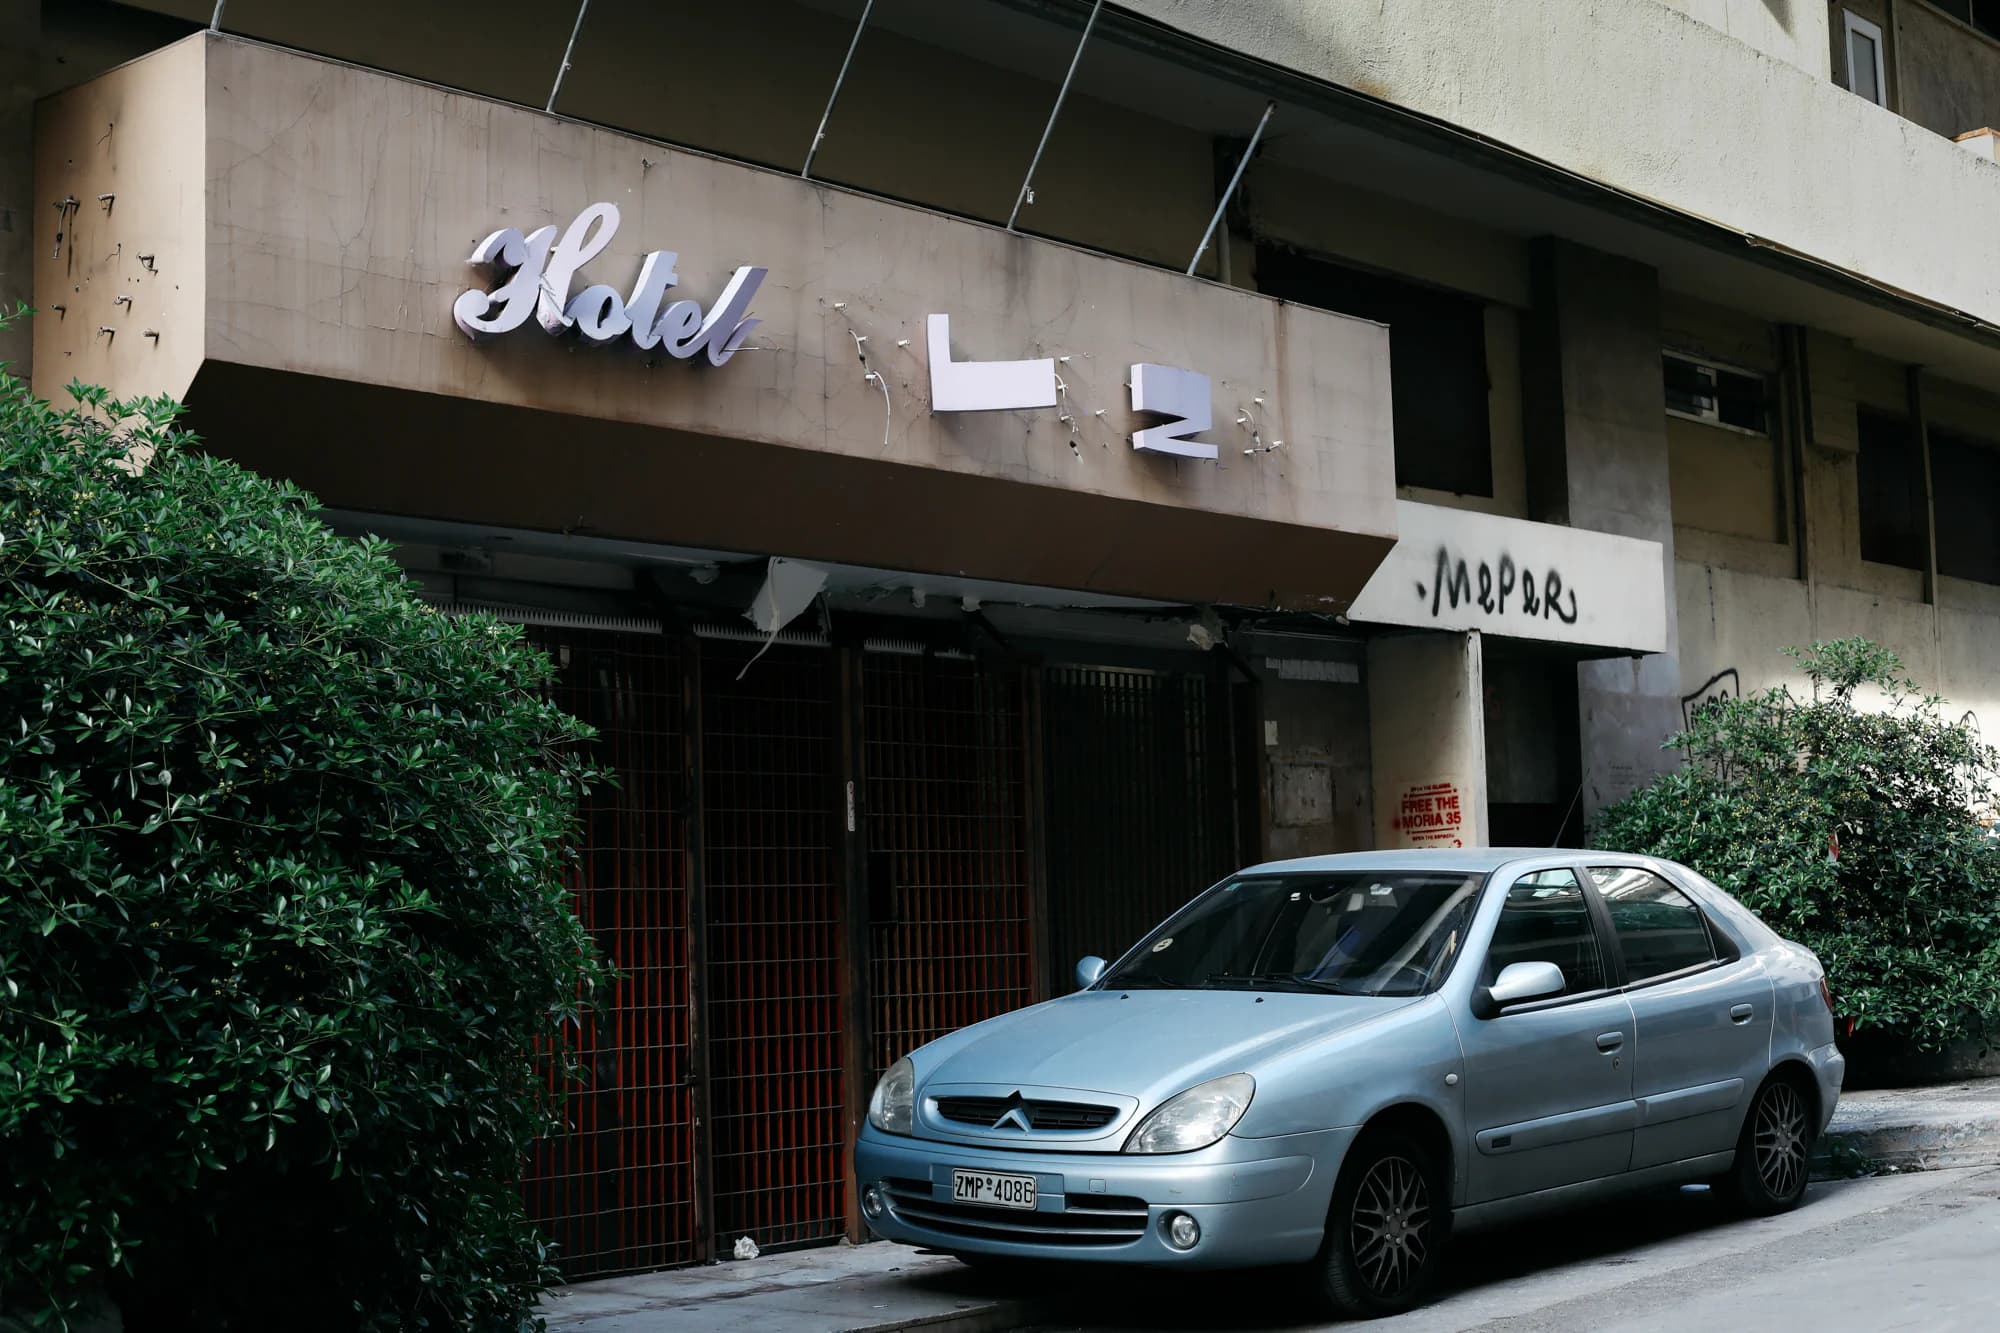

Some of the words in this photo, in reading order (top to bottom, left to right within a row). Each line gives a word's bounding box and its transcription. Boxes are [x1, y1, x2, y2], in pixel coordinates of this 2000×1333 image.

[453, 202, 768, 366] Hotel
[1402, 798, 1432, 814] FREE
[1435, 796, 1459, 810] THE
[1402, 813, 1444, 829] MORIA
[1446, 811, 1461, 825] 35
